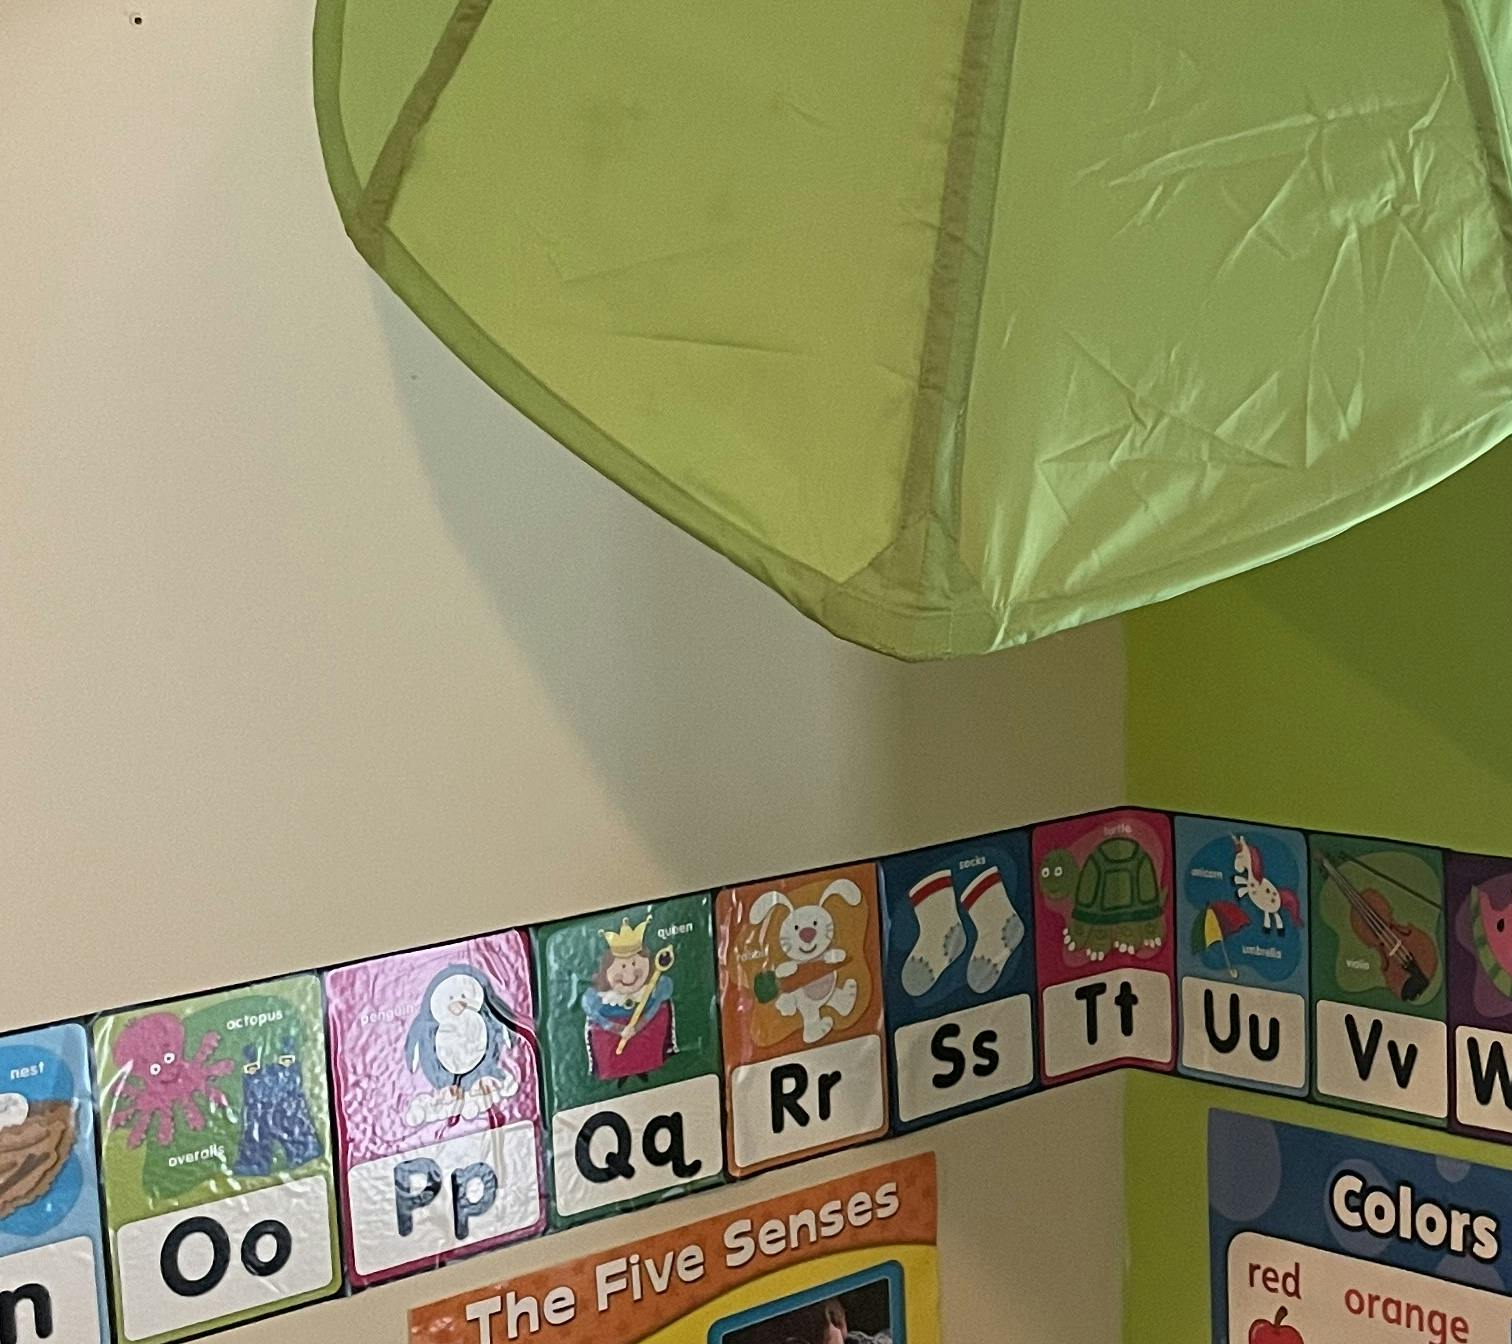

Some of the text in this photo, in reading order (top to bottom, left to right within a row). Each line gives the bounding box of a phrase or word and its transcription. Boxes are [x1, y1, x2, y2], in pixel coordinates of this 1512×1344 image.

[959, 856, 986, 870] socks
[226, 1010, 284, 1031] octopus
[1074, 981, 1139, 1046] Tt
[1203, 989, 1281, 1061] Uu
[10, 1061, 44, 1080] nest
[930, 1023, 1000, 1089] Ss
[1344, 1013, 1419, 1090] Vv
[769, 1063, 841, 1134] Rr
[168, 1144, 225, 1168] overalls
[574, 1111, 702, 1184] Qq
[393, 1157, 498, 1239] Pp
[1331, 1172, 1500, 1260] Colors
[160, 1216, 292, 1297] Oo
[595, 1244, 705, 1312] Five
[723, 1181, 900, 1268] Senses
[1248, 1262, 1301, 1301] red
